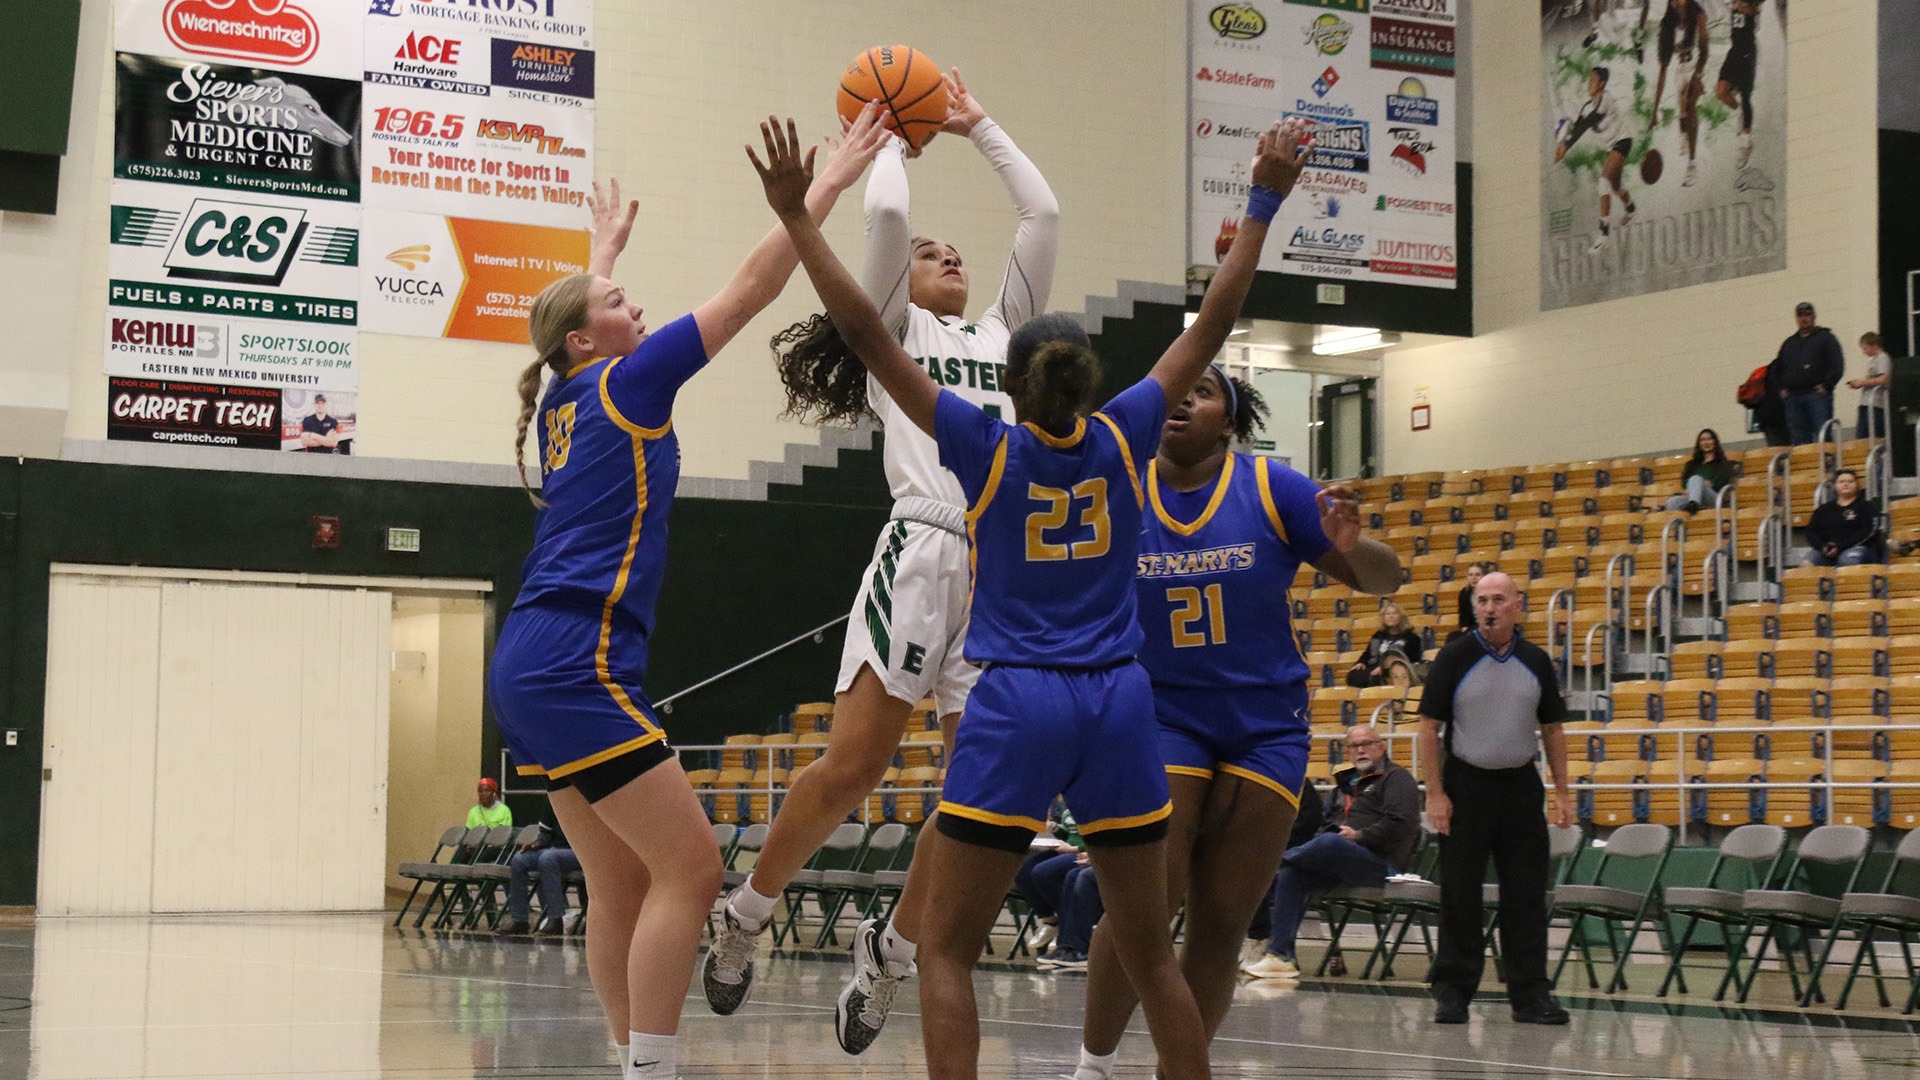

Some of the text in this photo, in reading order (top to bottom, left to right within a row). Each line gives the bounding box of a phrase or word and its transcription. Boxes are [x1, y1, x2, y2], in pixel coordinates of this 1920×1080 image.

[178, 12, 305, 47] Wienerschnitzel
[409, 4, 586, 37] MORTGAGE BANKING GROUP
[395, 30, 461, 64] ACE
[1372, 32, 1454, 53] INSURANCE
[512, 44, 576, 65] ASHLEY
[394, 61, 457, 78] Hardware
[512, 60, 574, 75] FURNITURE
[516, 70, 571, 83] Homestore
[167, 63, 283, 103] Sievers
[371, 72, 487, 95] FAMILY OWNED
[509, 90, 582, 107] SINCE 1956
[1296, 99, 1354, 116] Domino's
[196, 99, 298, 130] SPORTS
[170, 120, 313, 156] MEDICINE
[371, 132, 458, 148] ROSWELL'S TALK FM
[165, 144, 312, 172] & URGENT CARE
[389, 147, 570, 183] Your Source for Sports in
[226, 174, 348, 196] SieversSportsMed.com
[371, 166, 585, 208] Roswell and the Pecos Valley
[1315, 172, 1367, 194] AGAVES
[185, 209, 287, 263] C&S
[474, 253, 584, 273] Internet TV Voice
[375, 276, 444, 297] YUCCA
[113, 286, 354, 320] FUELS PARTS TIRES
[385, 295, 434, 305] TELECOM
[486, 292, 516, 306] (575)
[240, 334, 351, 355] SPORTSLOOK
[239, 354, 352, 369] THURSDAYS AT 9:00 PM
[143, 363, 319, 384] EASTERN NEW MEXICO UNIVERSITY
[112, 379, 137, 387] FLOOR
[169, 384, 219, 393] DISINFECTING
[228, 388, 278, 397] RESTORATION
[114, 394, 274, 428] CARPET TECH
[153, 431, 237, 444] carpettech.com
[1025, 477, 1111, 561] 23
[393, 531, 414, 549] EXIT
[1166, 584, 1226, 648] 21
[901, 641, 926, 675] E
